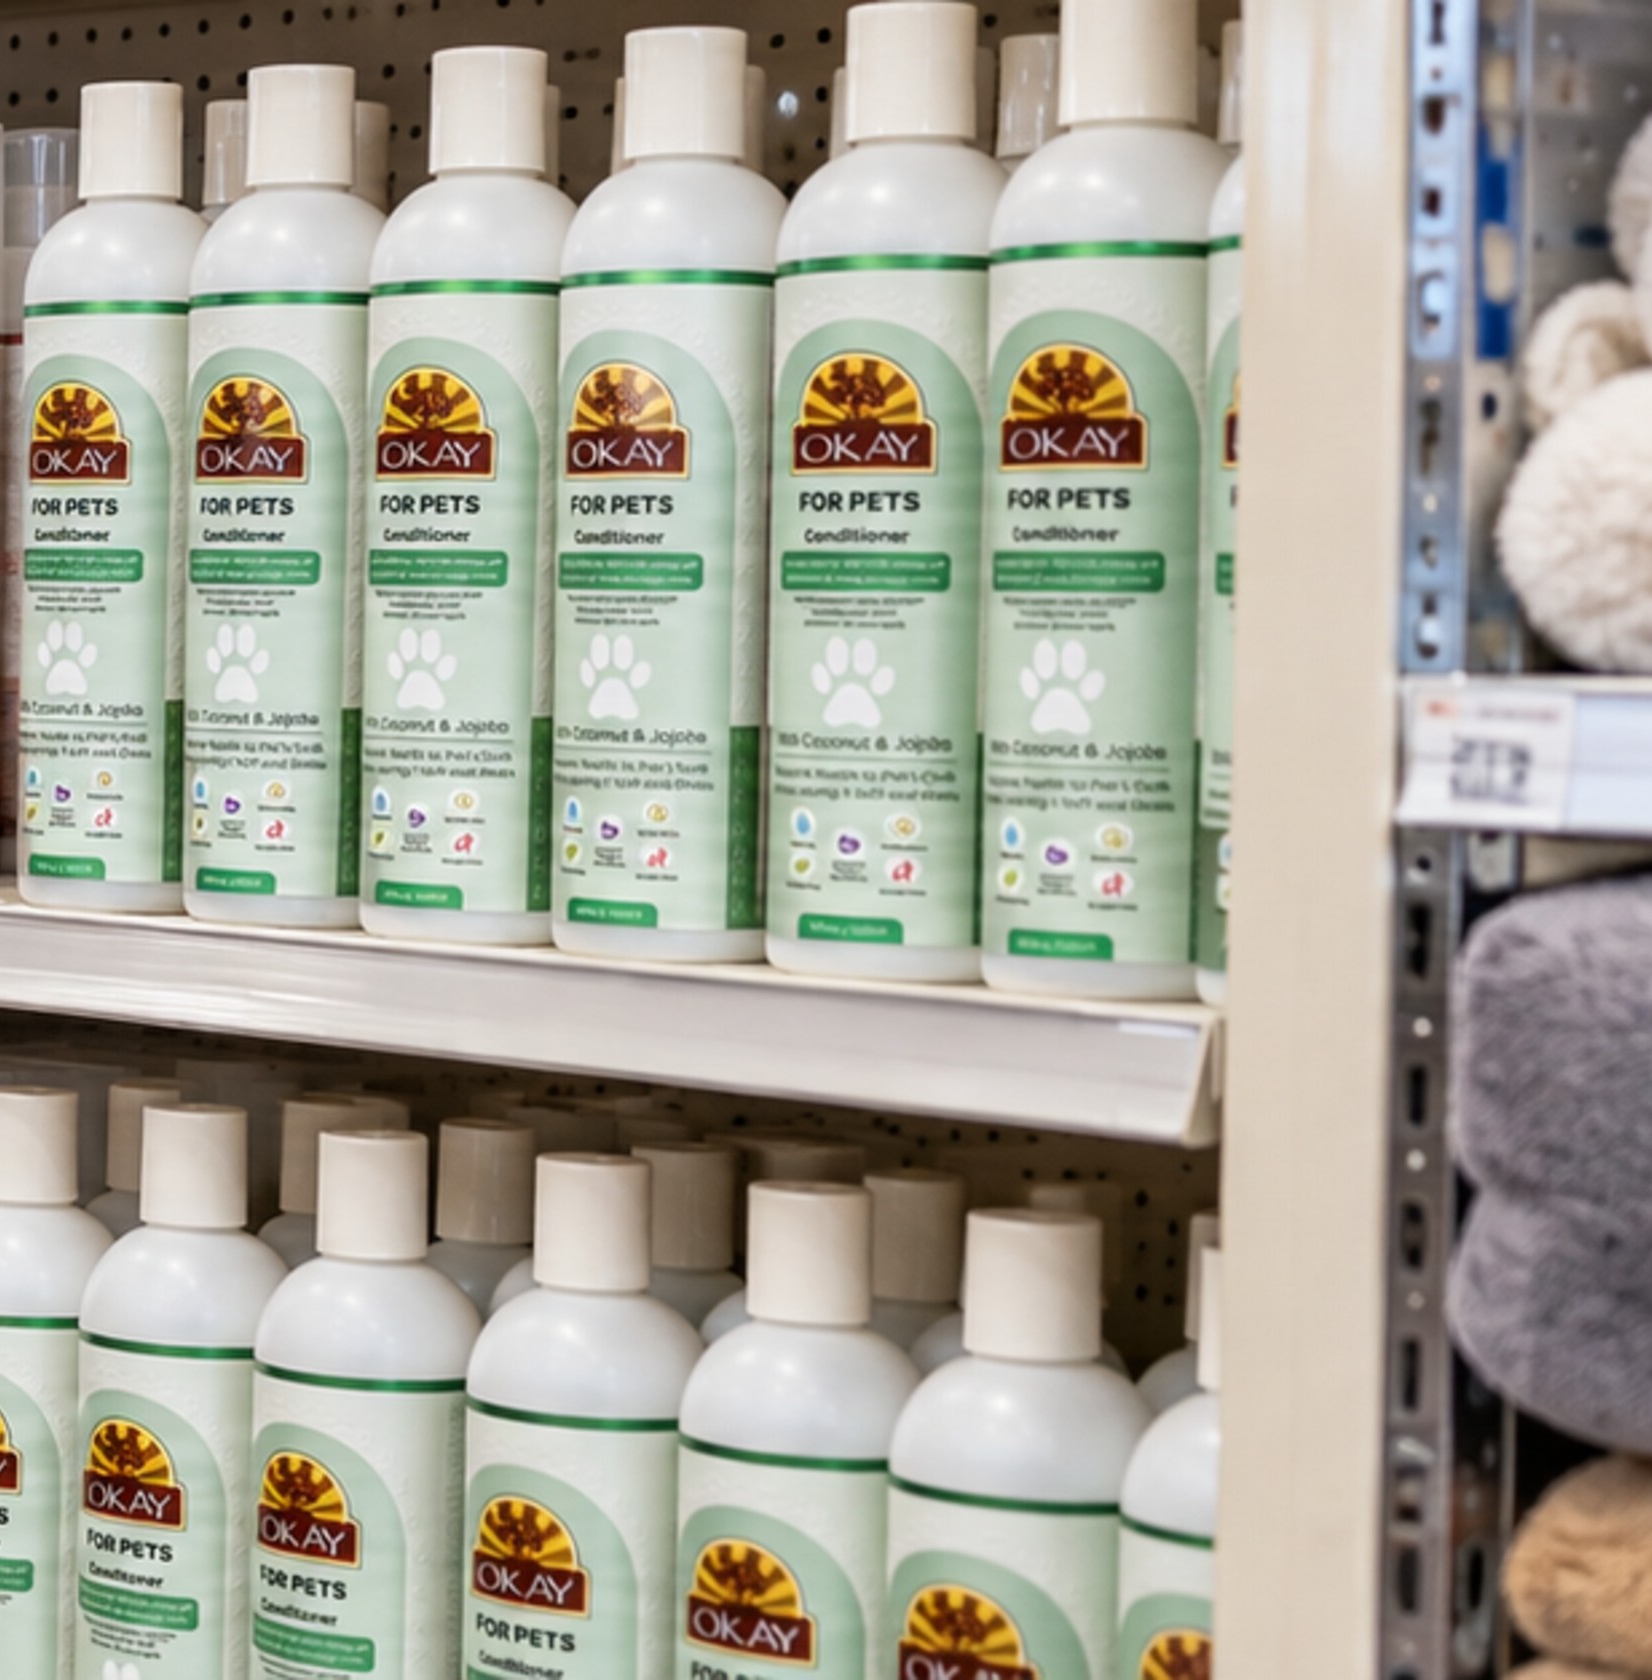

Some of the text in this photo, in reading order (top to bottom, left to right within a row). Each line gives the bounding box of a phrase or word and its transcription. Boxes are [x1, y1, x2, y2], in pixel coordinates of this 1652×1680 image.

[381, 440, 481, 470] OKAY
[571, 438, 673, 469] OKAY
[800, 430, 918, 464] OKAY
[1009, 426, 1129, 460] OKAY
[32, 449, 117, 475] OKAY
[200, 446, 294, 473] OKAY
[65, 498, 119, 516] PETS
[236, 497, 294, 516] PETS
[381, 494, 480, 515] FOR PETS
[571, 494, 673, 516] FOR PETS
[799, 491, 921, 513] FOR PETS
[1007, 487, 1131, 510] FOR PETS
[804, 526, 910, 544] Conditioner
[88, 1480, 172, 1520] OKAY
[87, 1528, 174, 1563] FOR PETS
[260, 1514, 346, 1557] OKAY
[260, 1564, 348, 1601] FOR PETS
[477, 1561, 574, 1605] OKAY
[476, 1613, 576, 1653] FOR PETS
[692, 1606, 799, 1654] OKAY
